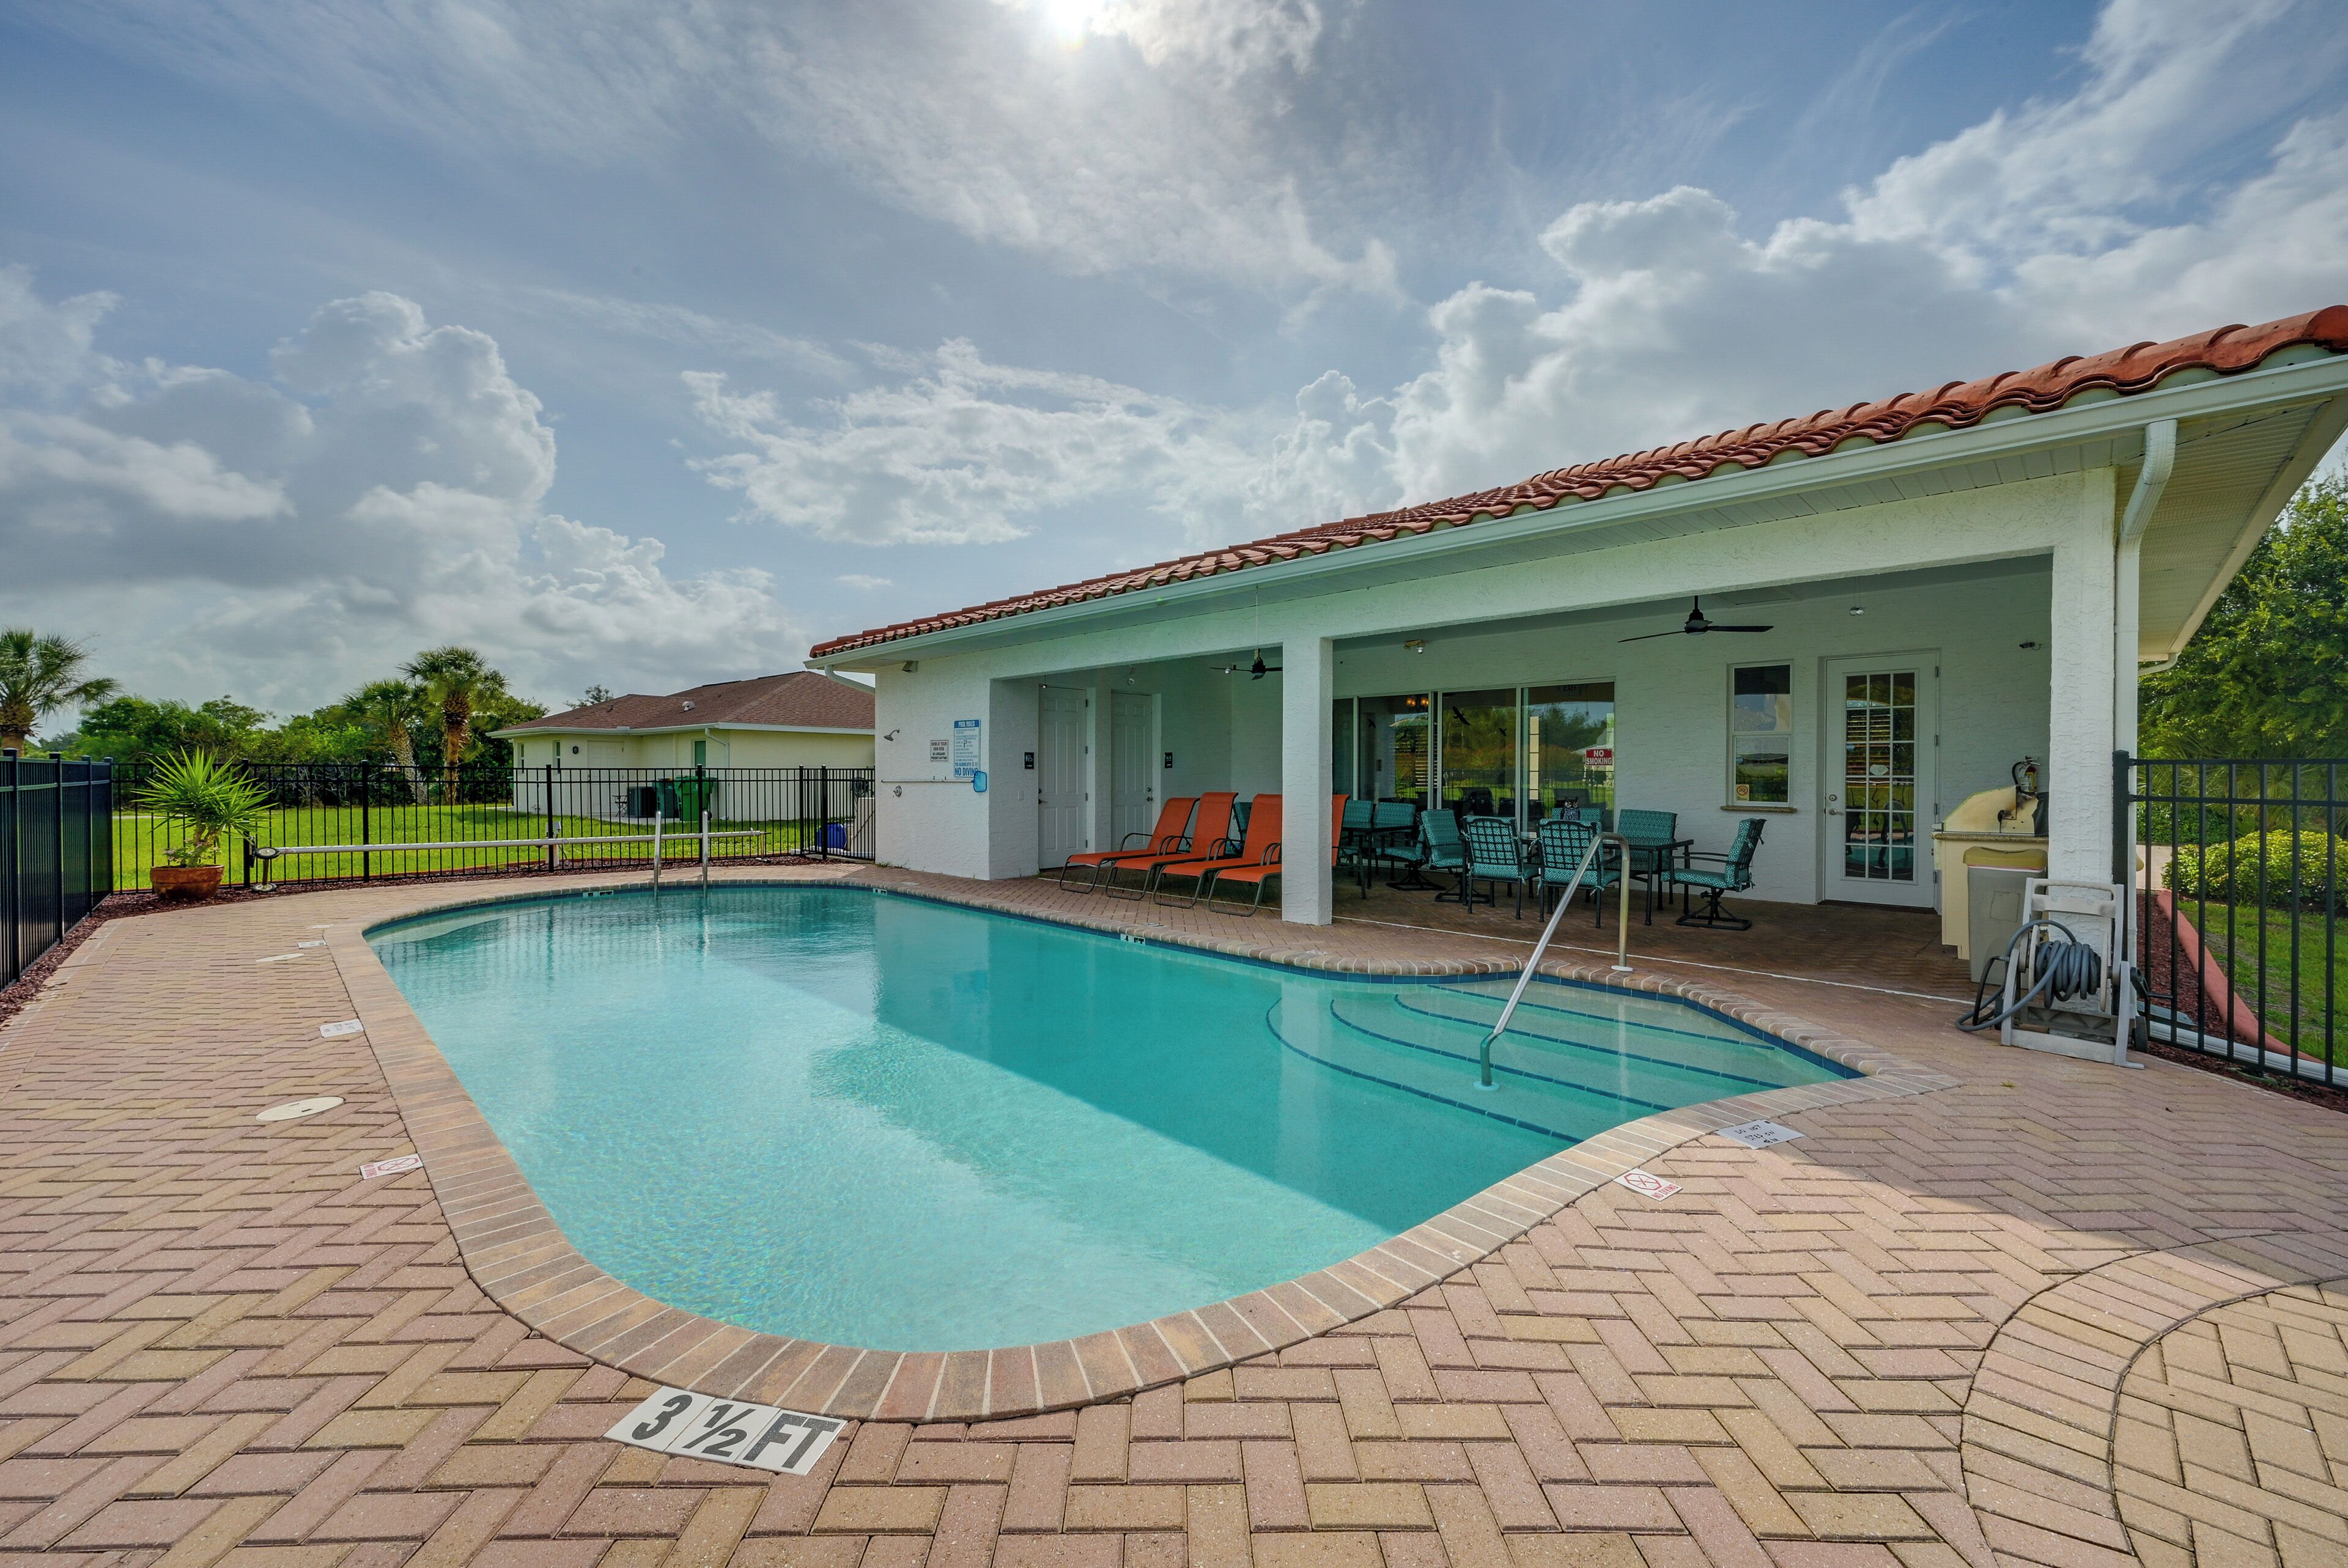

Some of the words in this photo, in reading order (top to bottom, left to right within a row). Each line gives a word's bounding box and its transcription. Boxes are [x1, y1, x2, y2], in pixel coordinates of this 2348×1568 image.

[954, 767, 962, 776] NO
[1658, 1183, 1678, 1195] DIVING
[632, 1394, 692, 1440] 3
[743, 1413, 840, 1469] FT
